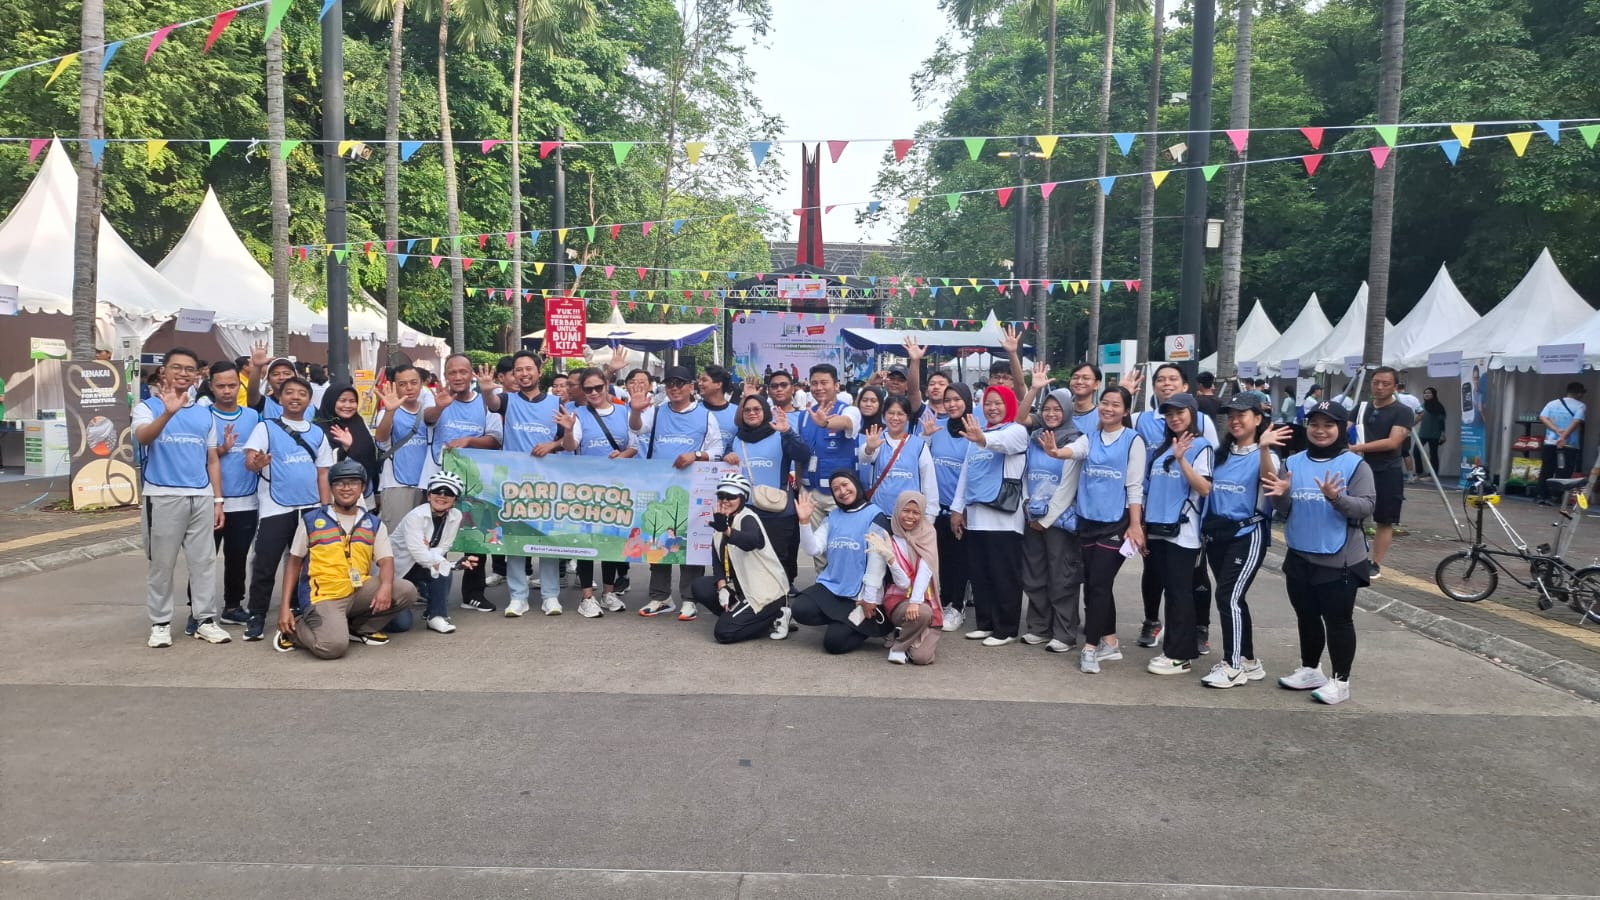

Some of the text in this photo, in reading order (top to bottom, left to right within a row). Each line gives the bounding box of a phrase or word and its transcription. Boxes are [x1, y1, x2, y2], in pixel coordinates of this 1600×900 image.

[552, 331, 581, 341] BUMI
[555, 341, 578, 350] KITA
[81, 369, 110, 378] KENAKAI
[512, 422, 551, 435] JAKPRO
[658, 435, 695, 446] JAKPRO
[1030, 472, 1059, 482] KPRO
[1213, 484, 1247, 494] KPRO
[502, 482, 633, 507] DARI BOTOL
[1290, 490, 1326, 502] AKPR
[500, 501, 633, 526] JADI POHON
